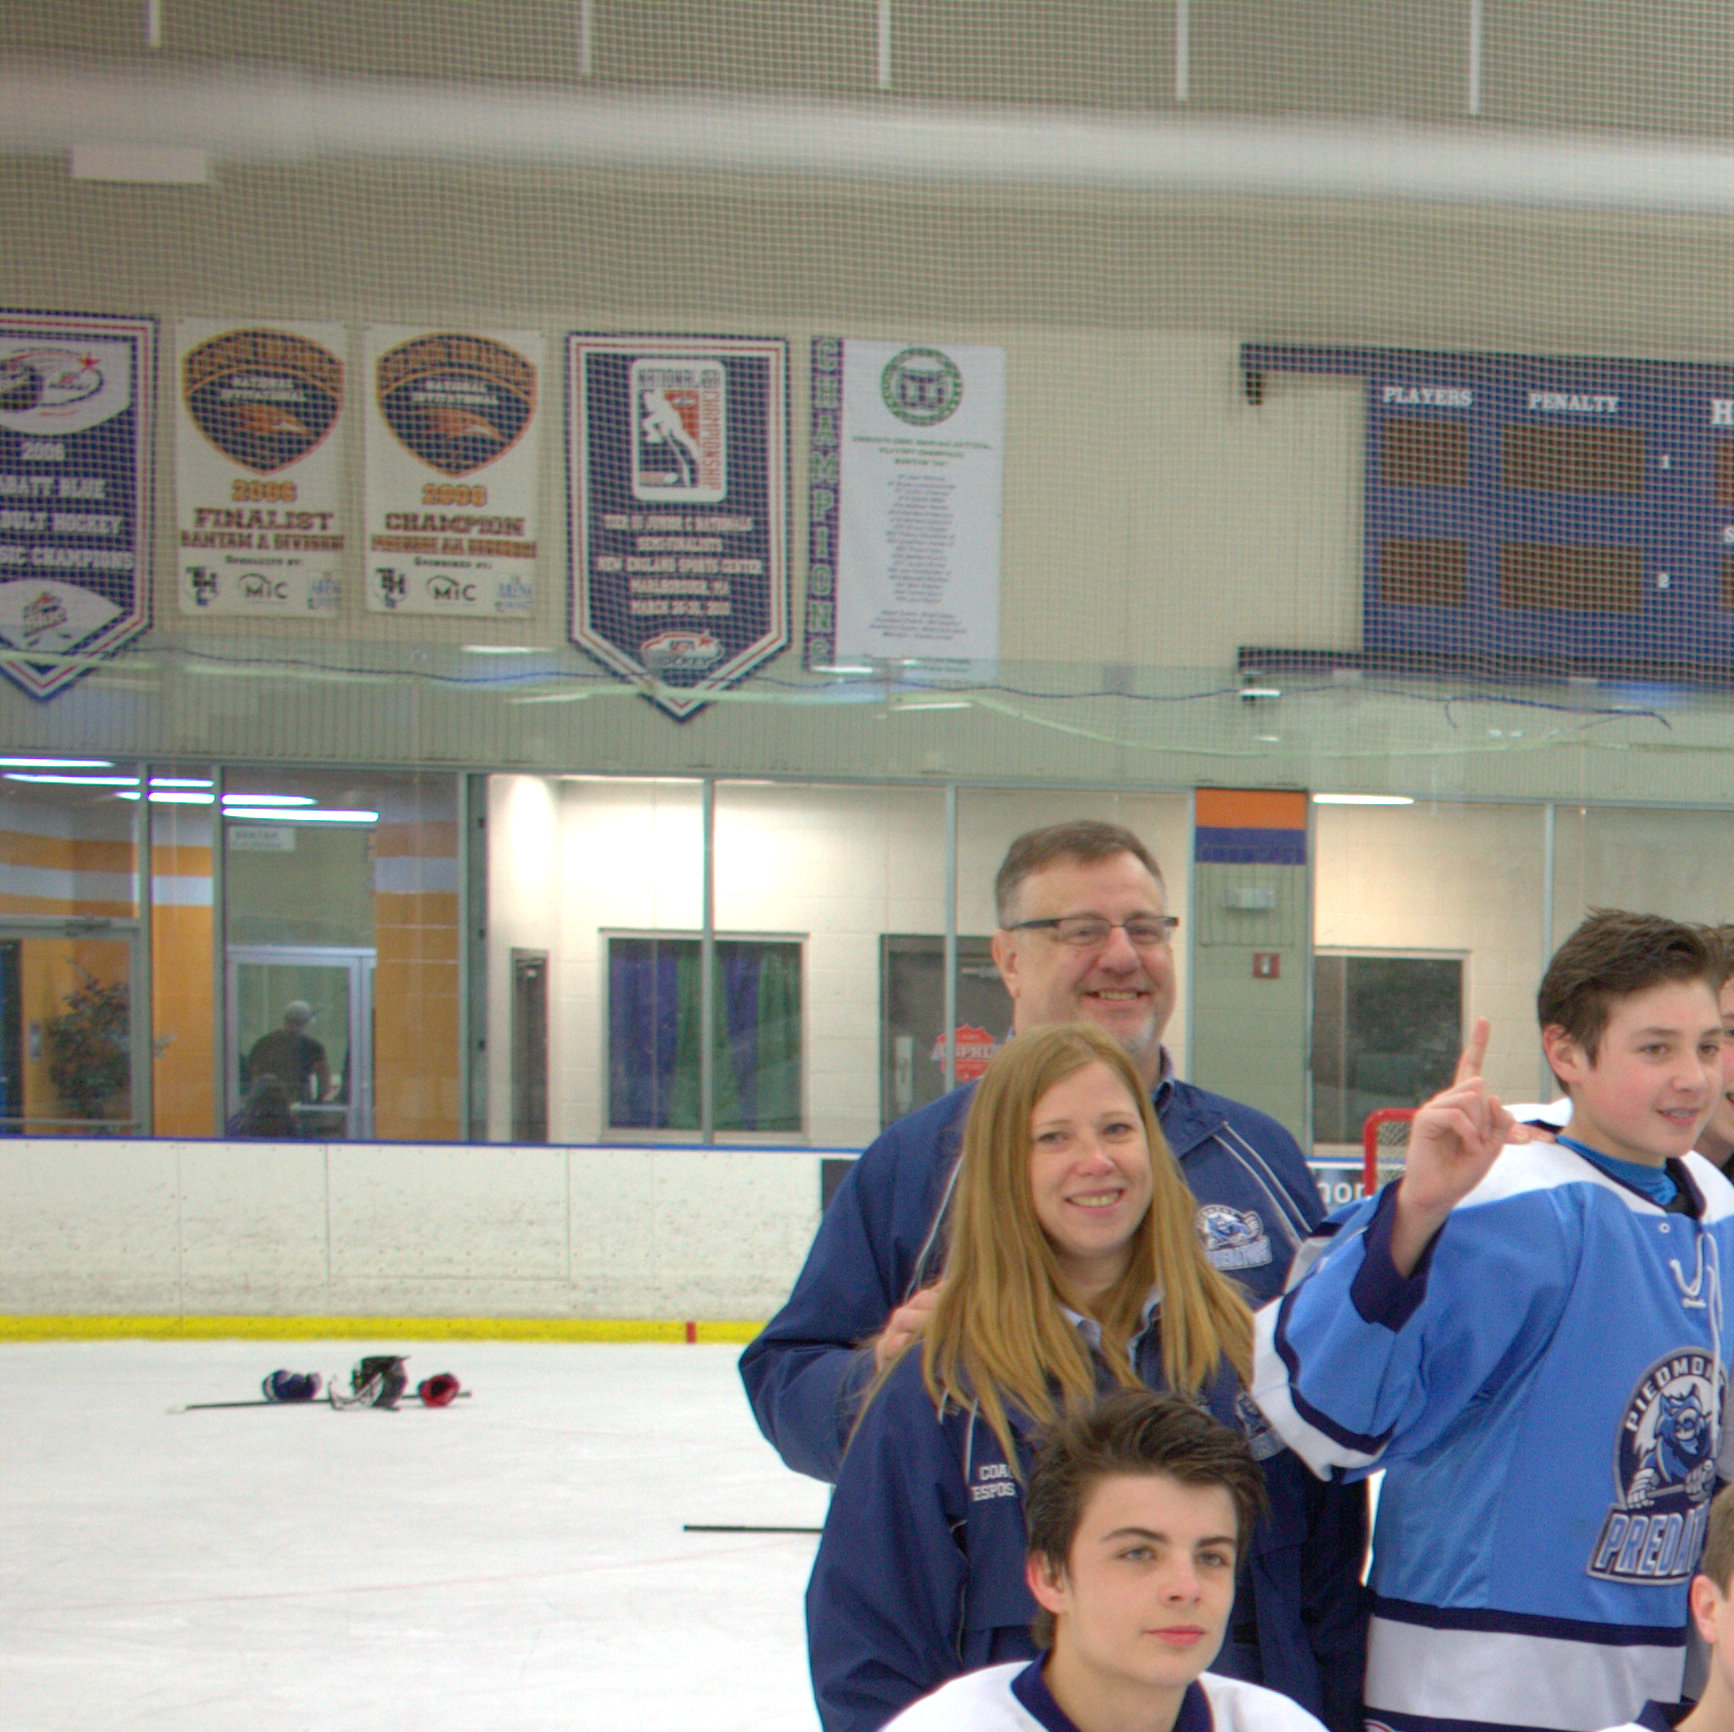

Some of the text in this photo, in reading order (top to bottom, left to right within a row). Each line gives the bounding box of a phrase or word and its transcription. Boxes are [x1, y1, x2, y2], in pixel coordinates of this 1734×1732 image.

[1382, 386, 1620, 413] PLAYERS PENALTY
[194, 508, 334, 531] FINALIST
[385, 512, 526, 537] CHAMPION
